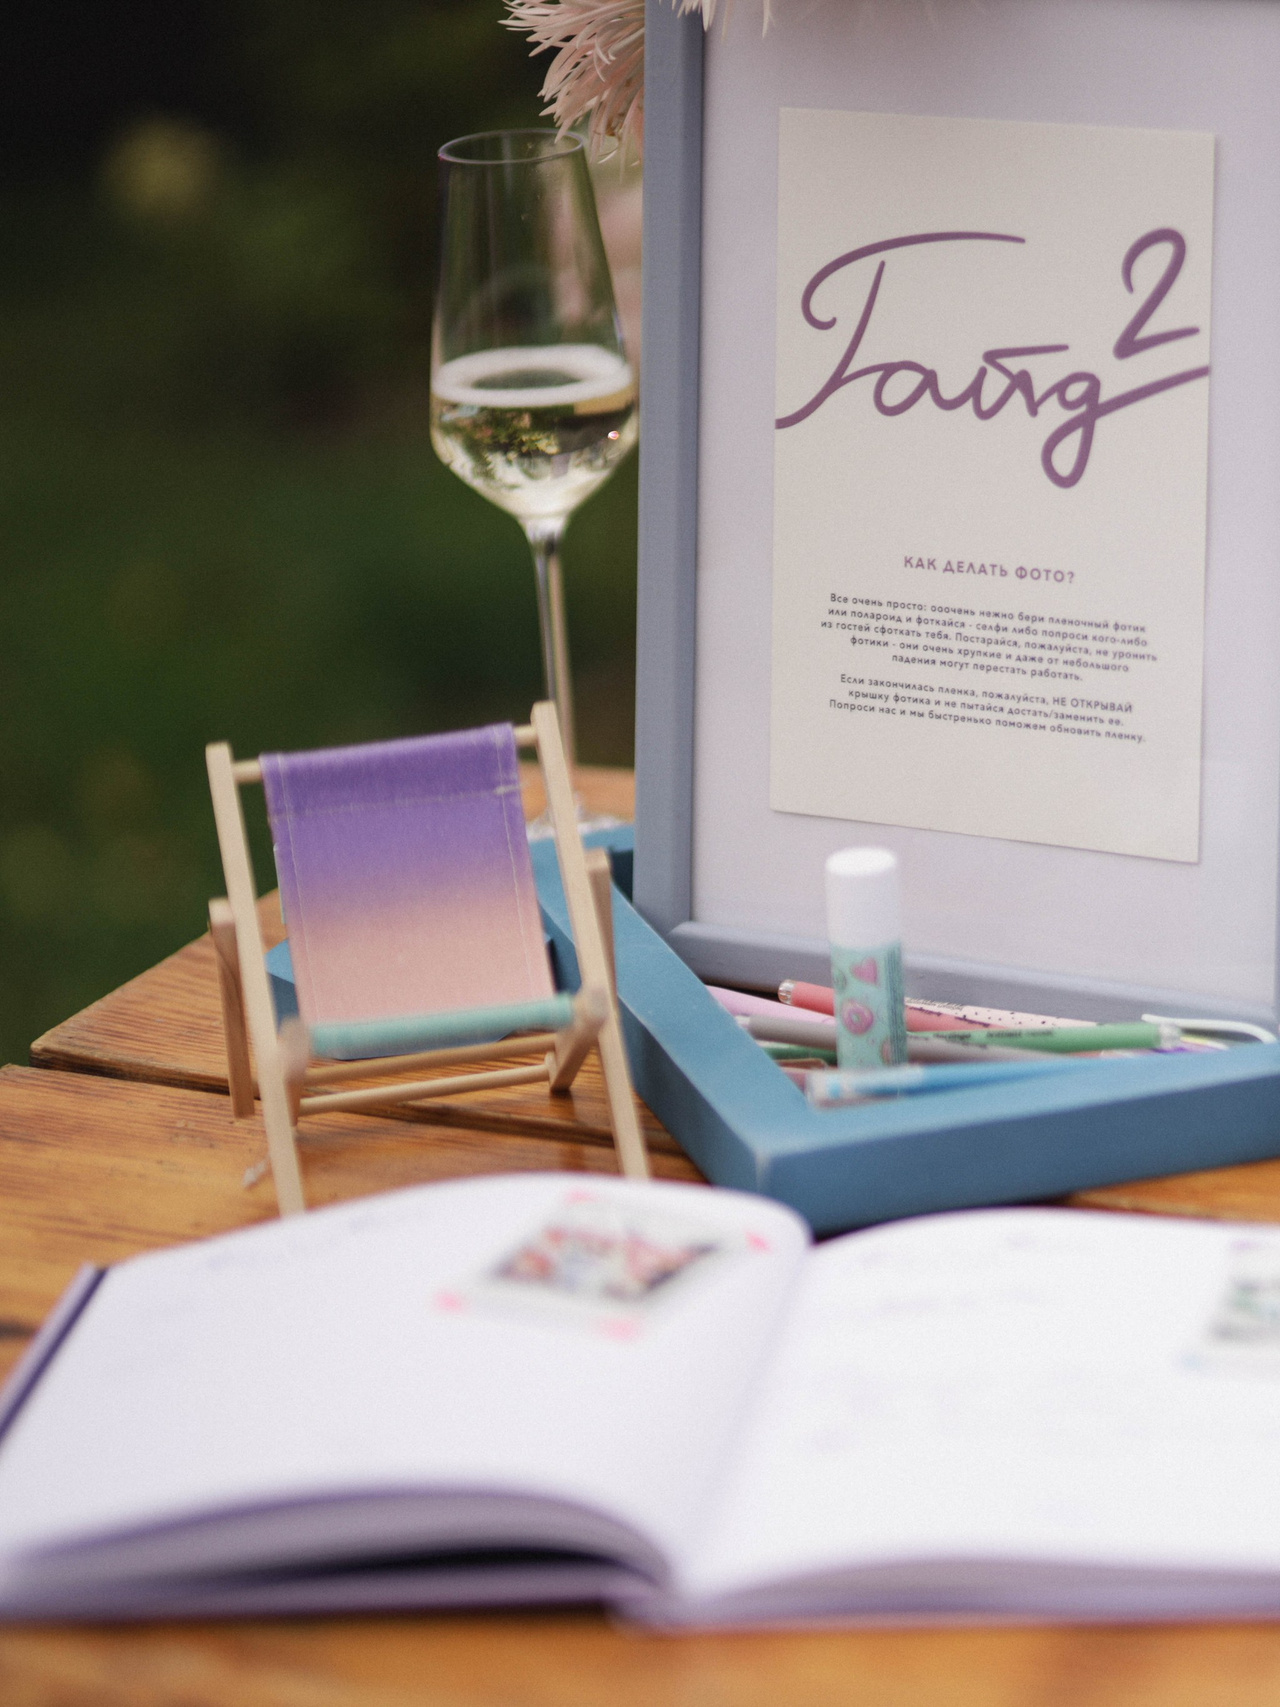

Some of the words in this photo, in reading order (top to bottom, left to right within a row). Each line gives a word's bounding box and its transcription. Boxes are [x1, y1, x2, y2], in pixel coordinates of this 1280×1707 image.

[1112, 227, 1201, 361] 2
[904, 556, 937, 571] КАК
[942, 560, 1008, 577] ДЕЛАТЬ
[1015, 565, 1074, 584] ФОТО?
[828, 608, 847, 617] или
[850, 610, 903, 623] полароид
[915, 614, 966, 628] фоткайся
[976, 622, 1008, 634] селфи
[1011, 625, 1038, 636] либо
[1041, 629, 1088, 641] попроси
[1092, 635, 1148, 647] кого-либо
[830, 592, 849, 604] Все
[851, 597, 883, 607] очень
[886, 600, 926, 611] просто:
[930, 605, 976, 616] ооочень
[979, 610, 1014, 620] нежно
[1017, 611, 1045, 624] бери
[1048, 616, 1109, 629] пленочный
[1113, 621, 1145, 633] фотик
[821, 621, 833, 629] из
[836, 622, 871, 632] гостей
[873, 624, 922, 638] сфоткать
[1095, 649, 1109, 657] не
[1112, 651, 1157, 662] уронить
[850, 635, 889, 647] фотики
[899, 642, 919, 650] они
[922, 644, 954, 654] очень
[957, 648, 1002, 659] хрупкие
[1015, 654, 1044, 664] даже
[1047, 657, 1059, 665] от
[1062, 657, 1129, 672] небольшого
[892, 654, 936, 666] падения
[939, 660, 969, 671] могут
[972, 663, 1027, 675] перестать
[1030, 668, 1082, 681] работать.
[840, 673, 865, 685] Если
[868, 678, 935, 693] закончилась
[1052, 696, 1066, 707] НЕ
[1070, 697, 1133, 713] ОТКРЫВАЙ
[848, 690, 889, 703] крышку
[893, 692, 931, 705] фотика
[960, 702, 1004, 713] пытайся
[829, 698, 875, 712] Попроси
[878, 707, 896, 715] нас
[909, 710, 925, 718] мы
[928, 709, 992, 725] быстренько
[995, 719, 1046, 731] поможем
[1049, 723, 1101, 737] обновить
